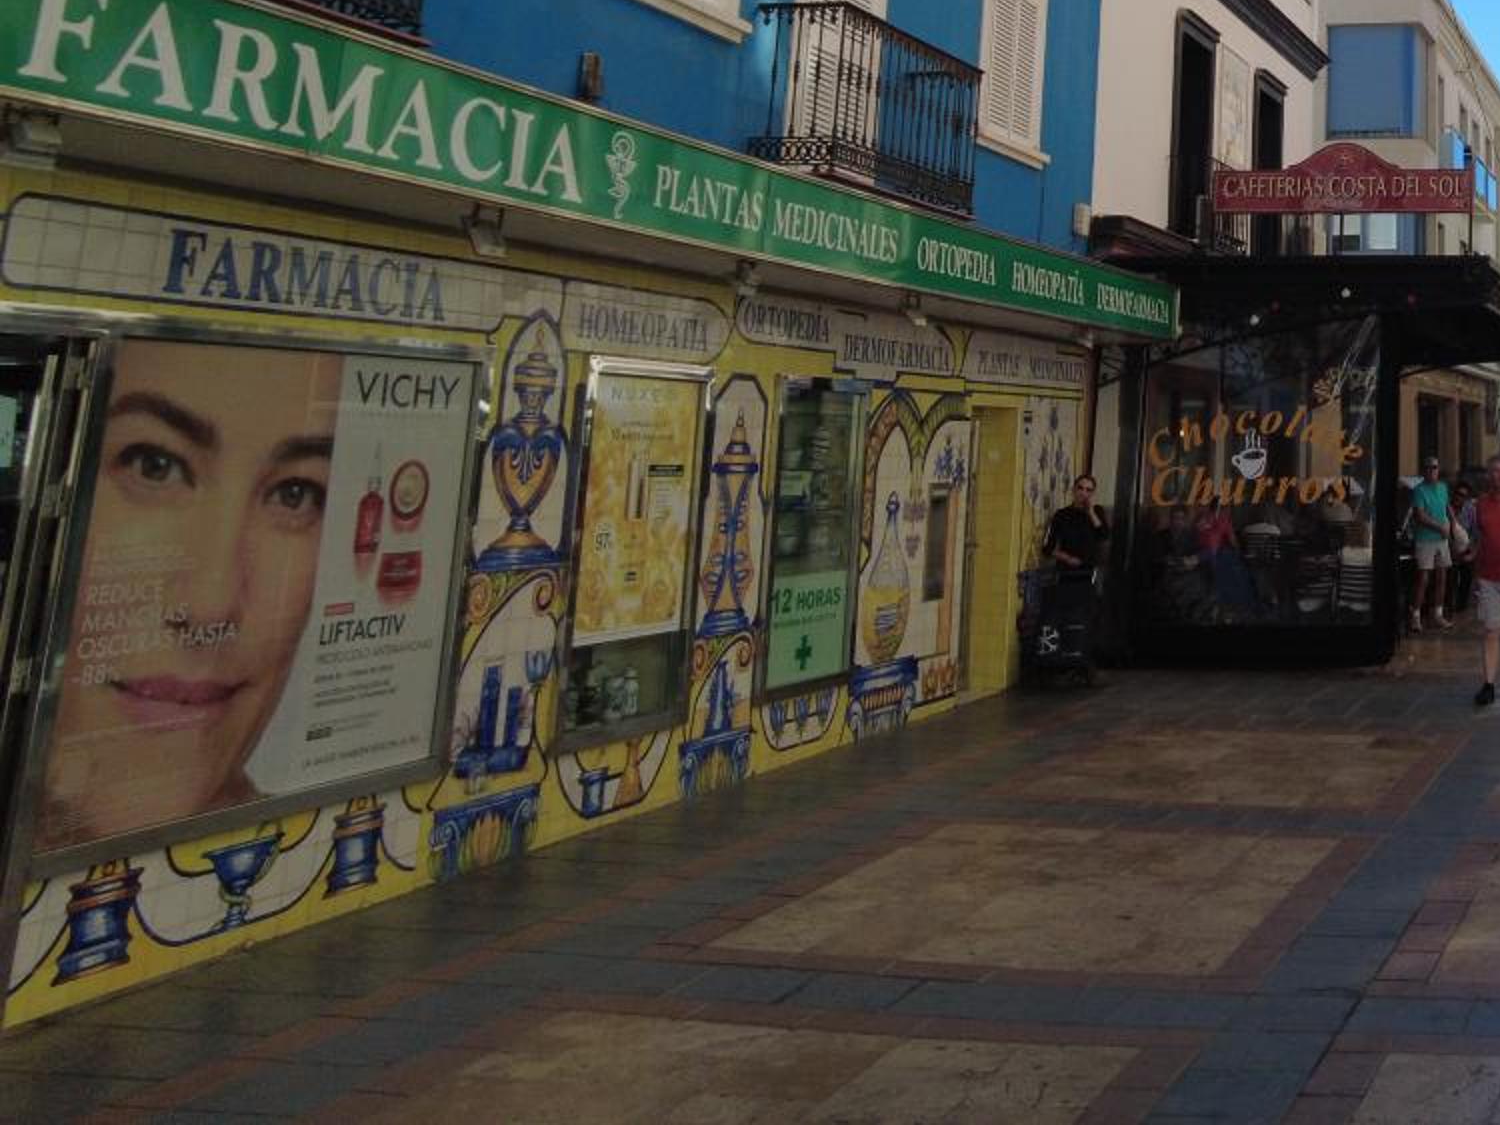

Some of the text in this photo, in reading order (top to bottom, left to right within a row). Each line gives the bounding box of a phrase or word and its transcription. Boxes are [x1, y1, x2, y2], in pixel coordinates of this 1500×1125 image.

[1222, 174, 1463, 200] CAFETERIAS COSTA DEL SOL
[653, 164, 765, 232] PLANTAS
[771, 198, 899, 264] MEDICINALES
[917, 236, 997, 286] ORTOPEDIA
[163, 228, 445, 322] FARMACIA
[357, 370, 461, 409] VICHY
[1151, 467, 1350, 508] Churros
[86, 583, 163, 607] REDUCE
[774, 586, 841, 614] 12 HORAS
[177, 619, 241, 651] HASTA
[319, 613, 406, 646] LIFTACTIV
